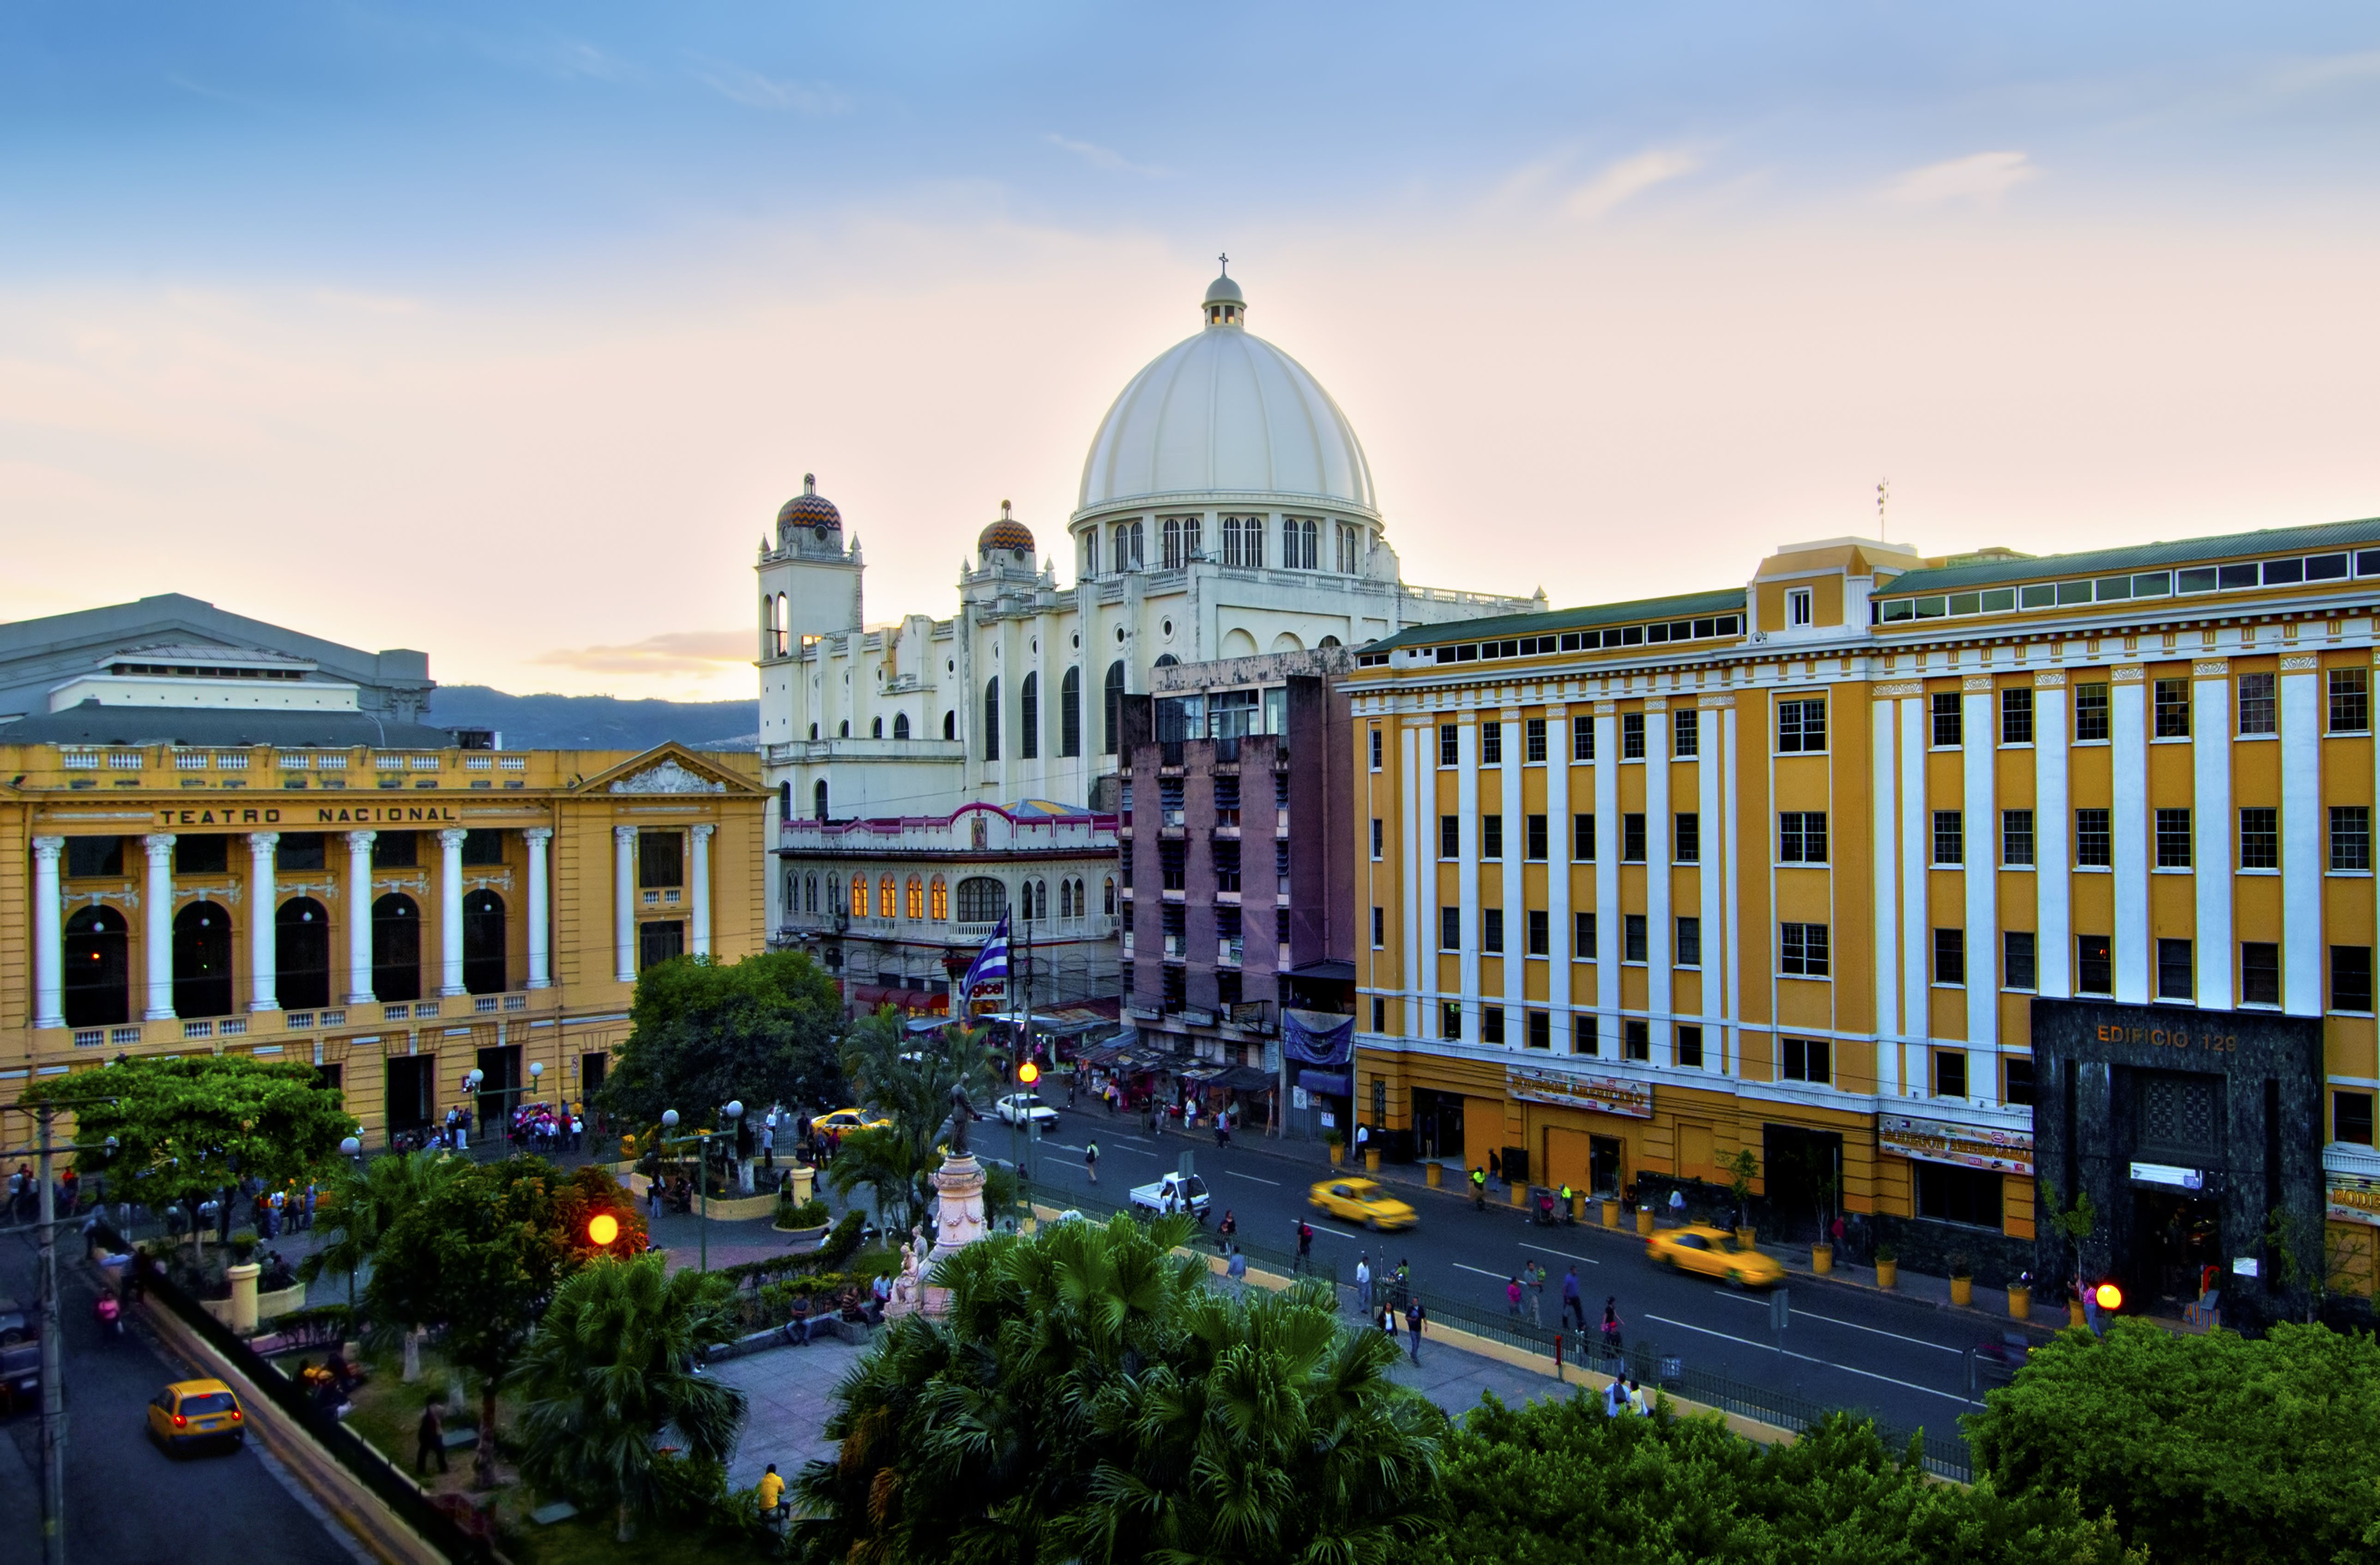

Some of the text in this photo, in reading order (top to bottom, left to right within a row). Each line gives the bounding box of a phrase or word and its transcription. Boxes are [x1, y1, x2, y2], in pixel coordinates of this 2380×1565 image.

[160, 807, 456, 824] TEATRO NACIONAL
[959, 980, 1004, 998] gicel
[2098, 1025, 2236, 1051] EDIFICIO 129
[1571, 1084, 1644, 1106] AMERICANO
[1884, 1128, 2031, 1163] BODEGON AMERICANO
